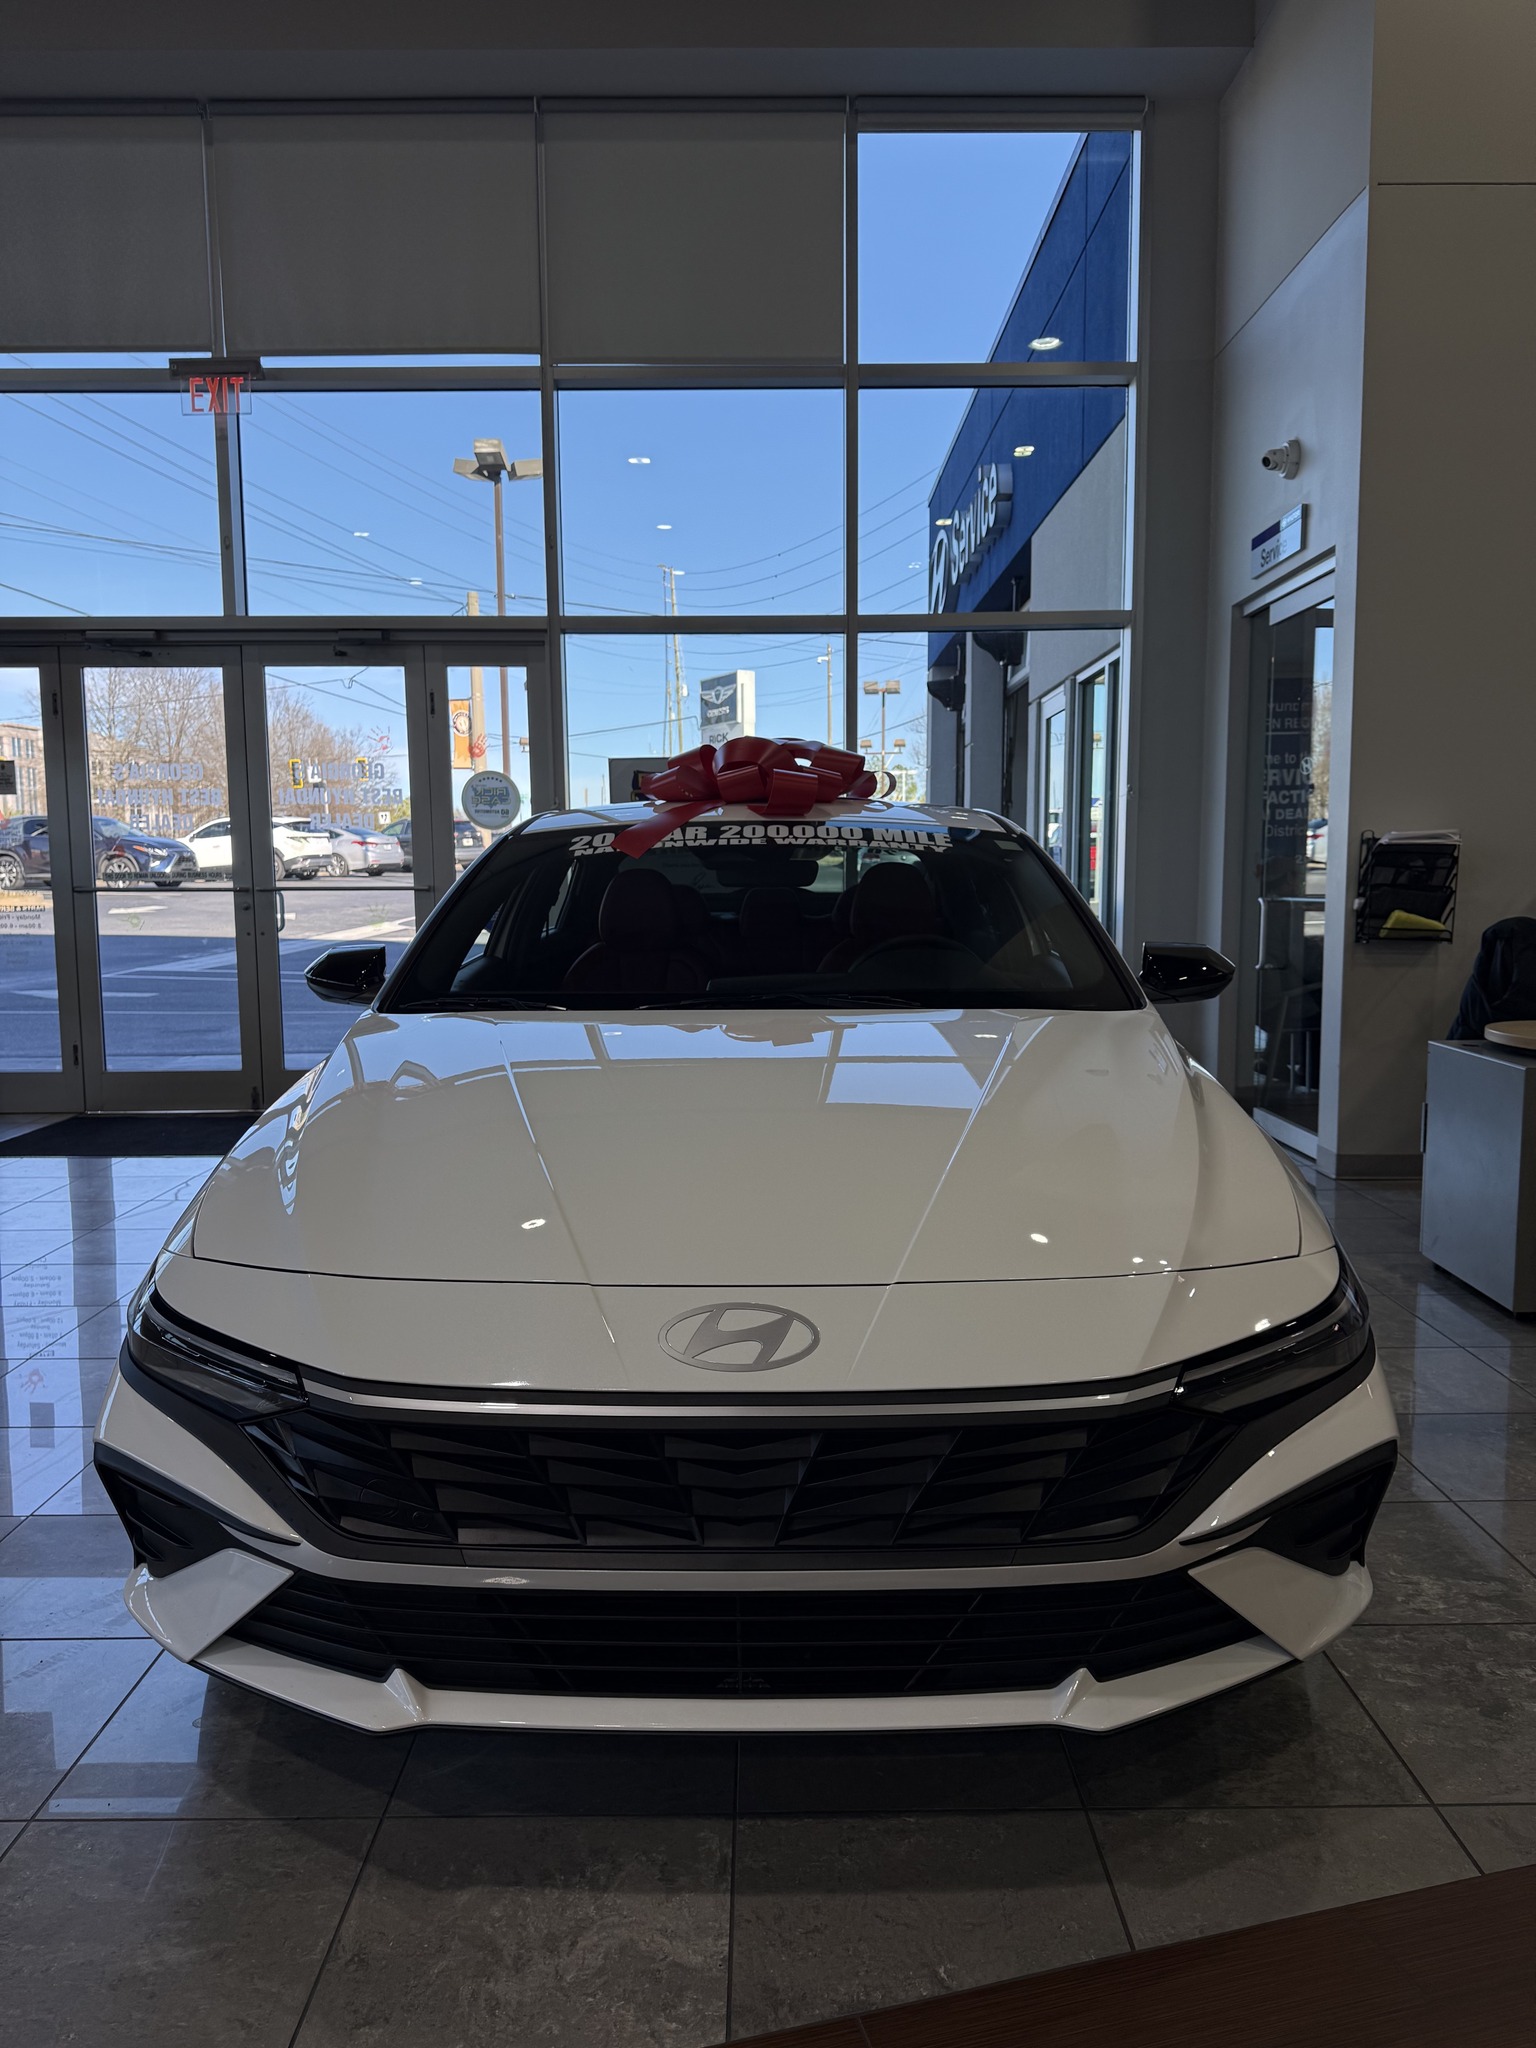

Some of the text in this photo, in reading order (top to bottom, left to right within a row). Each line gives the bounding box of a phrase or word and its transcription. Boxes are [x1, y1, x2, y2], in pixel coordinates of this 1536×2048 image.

[189, 377, 244, 413] EXIT
[950, 463, 998, 586] Service
[1260, 538, 1288, 568] Service
[709, 732, 729, 744] RICK
[569, 832, 616, 851] 20
[872, 827, 953, 848] MILE
[574, 838, 948, 857] NANWIDE WARRANTY
